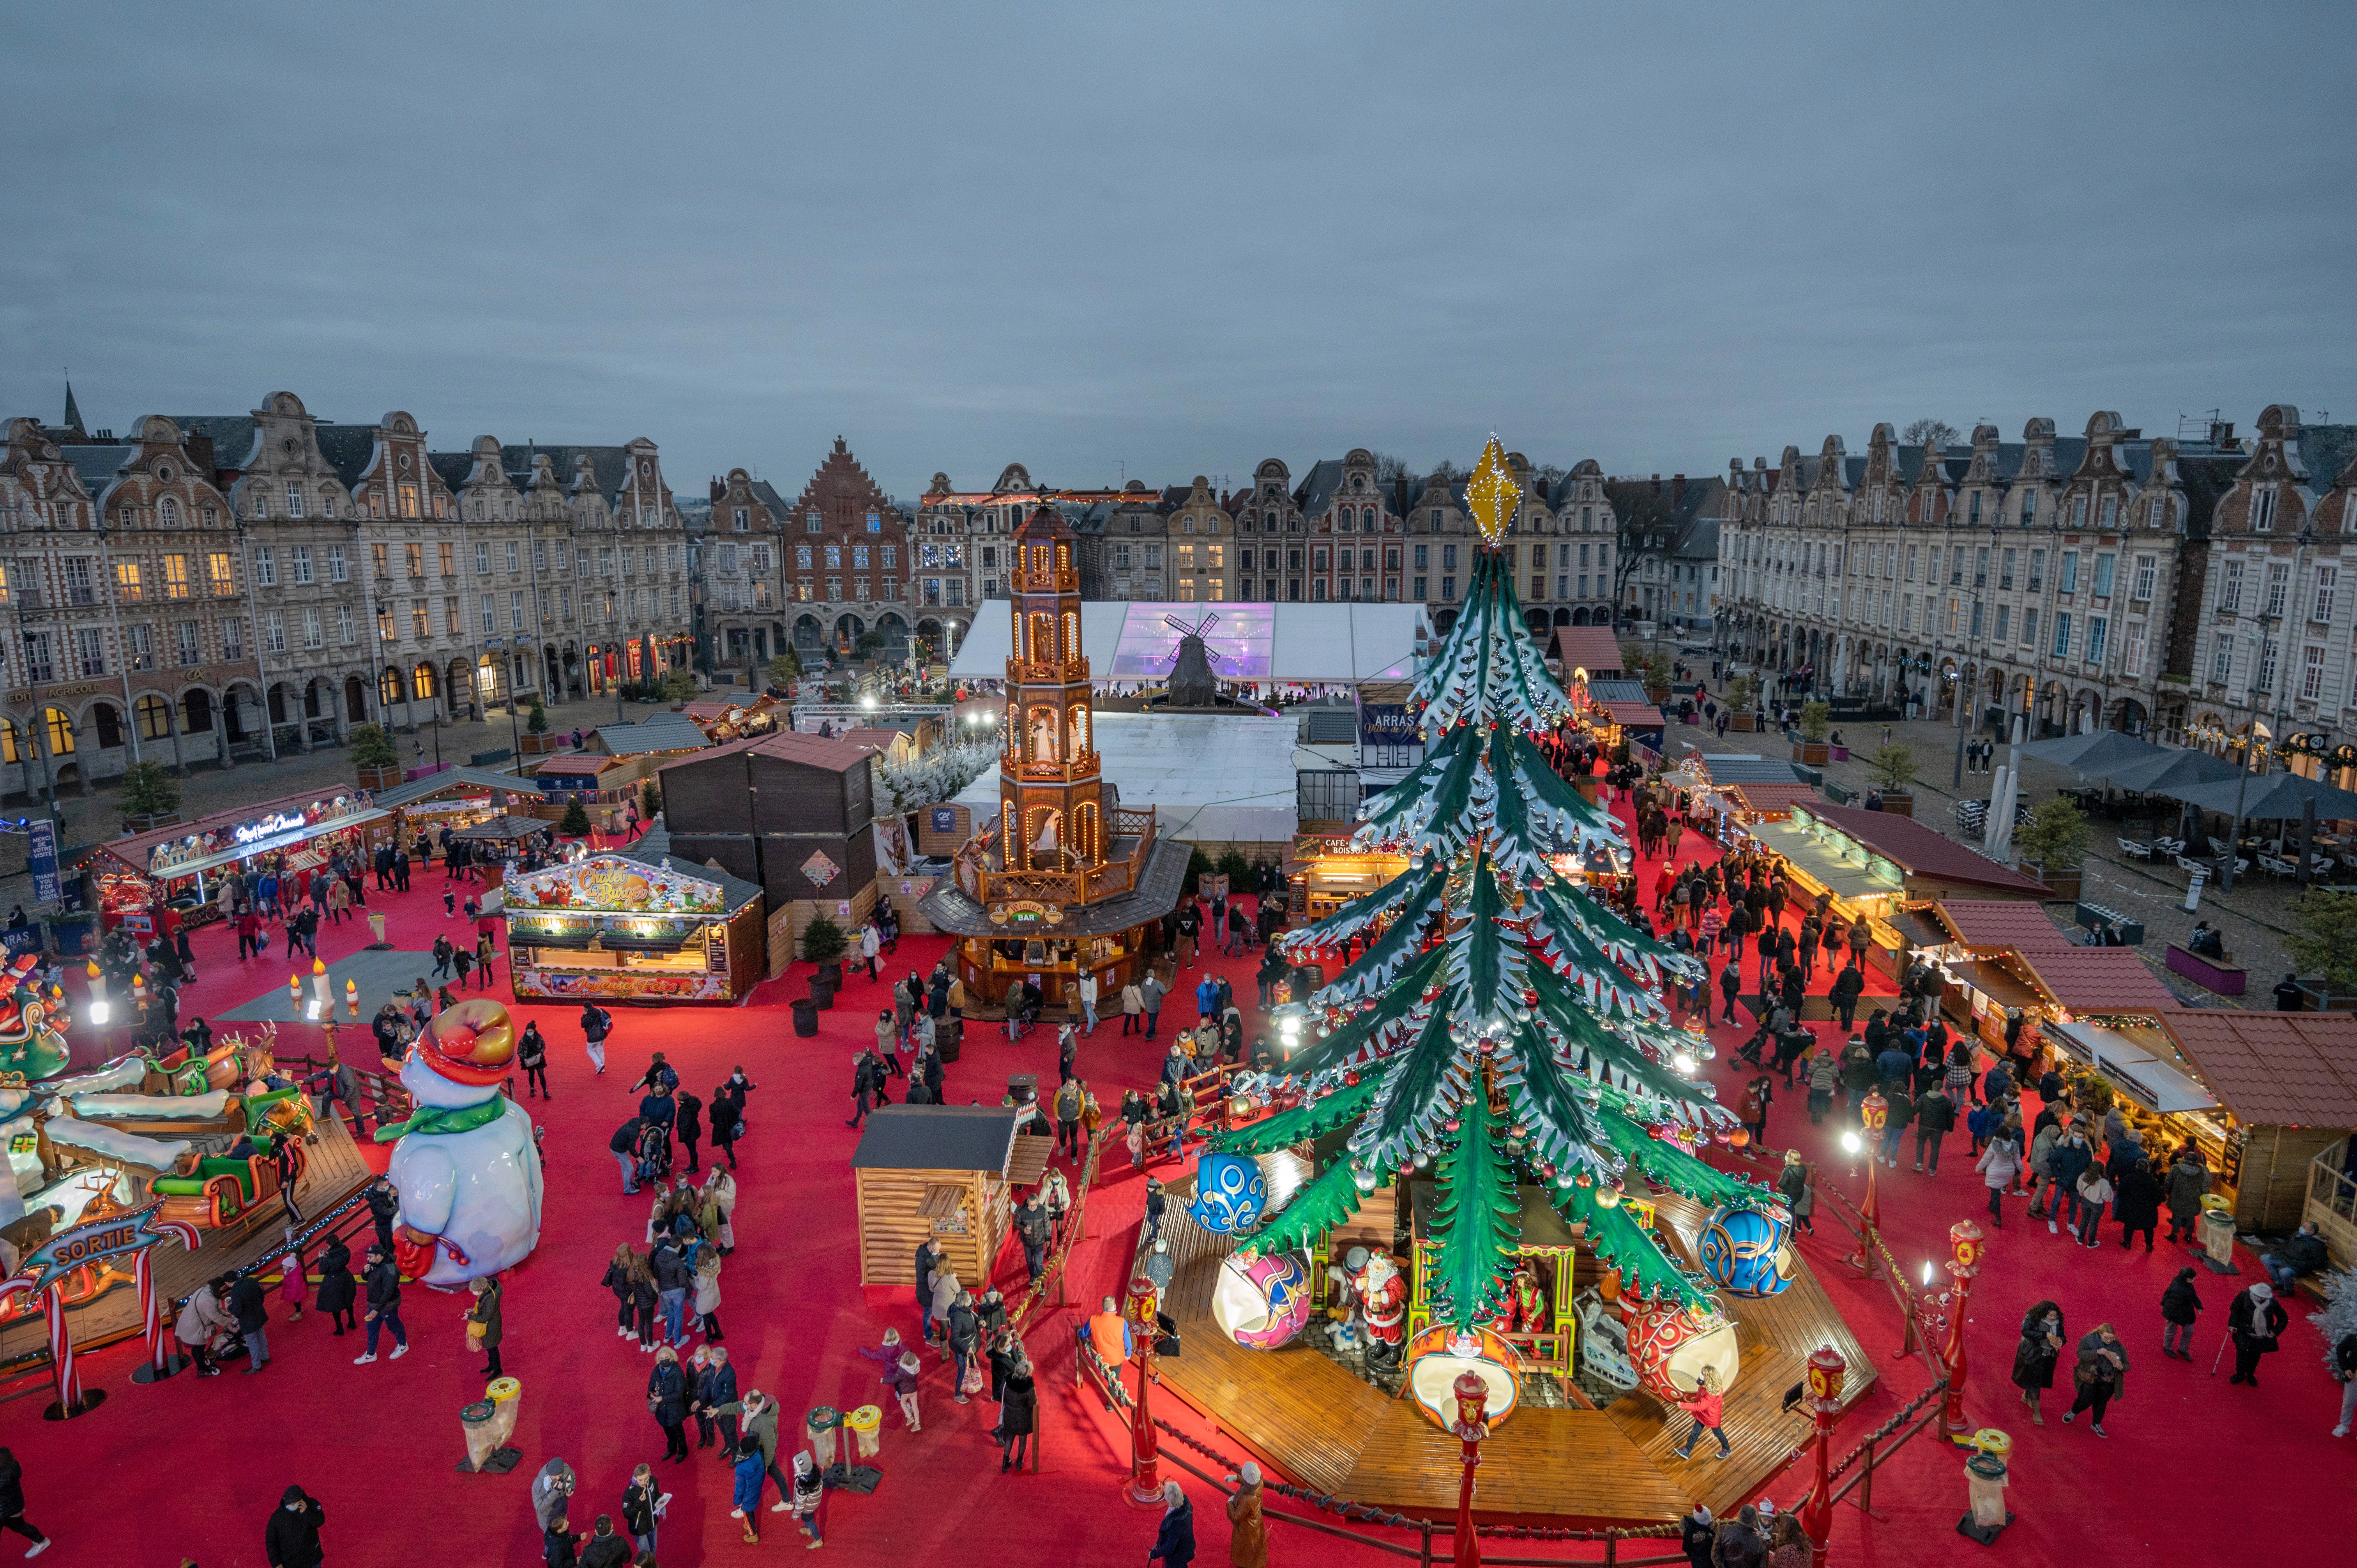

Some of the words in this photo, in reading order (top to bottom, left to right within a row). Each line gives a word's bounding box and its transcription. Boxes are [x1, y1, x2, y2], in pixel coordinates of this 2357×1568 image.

[516, 636, 532, 645] laforêt
[1375, 715, 1414, 727] ARRAS
[1364, 722, 1387, 734] Ville
[1326, 838, 1345, 846] CAFÉ
[577, 865, 626, 889] Chalet
[586, 888, 597, 897] du
[597, 884, 647, 908] Burger
[1010, 903, 1041, 912] Winter
[515, 916, 590, 929] HAMBURGER
[3, 931, 30, 946] RRAS
[568, 975, 635, 993] Joyeuses
[2100, 1061, 2114, 1074] Churros
[2164, 1117, 2179, 1130] Churros
[55, 1225, 136, 1266] SORTIE
